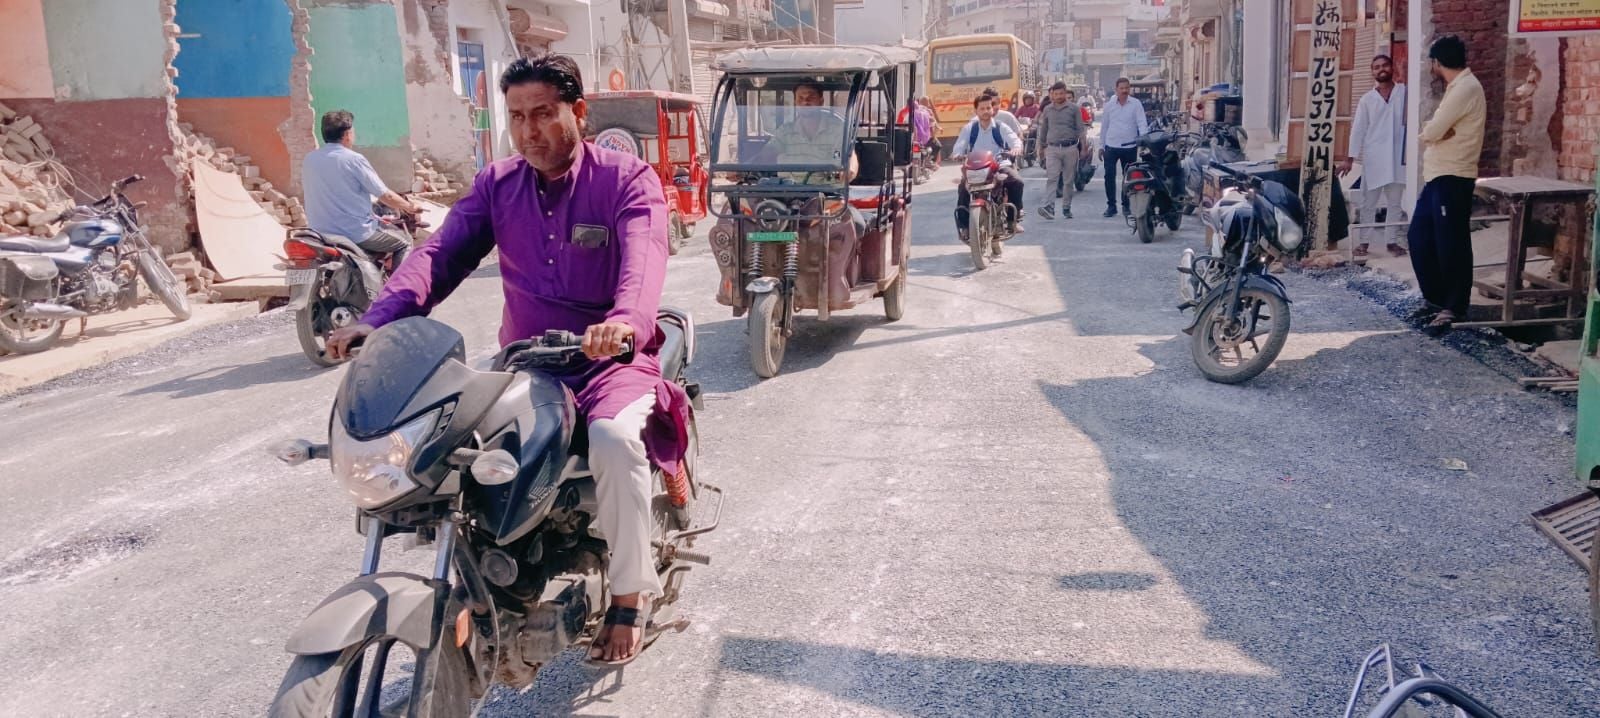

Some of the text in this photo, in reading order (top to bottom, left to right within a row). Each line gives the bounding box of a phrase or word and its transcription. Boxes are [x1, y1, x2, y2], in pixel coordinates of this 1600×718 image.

[1313, 57, 1336, 79] 75
[1311, 78, 1336, 98] 05
[1309, 99, 1335, 119] 37
[1308, 121, 1333, 143] 32
[1307, 145, 1330, 171] 14
[528, 483, 556, 509] HONDA
